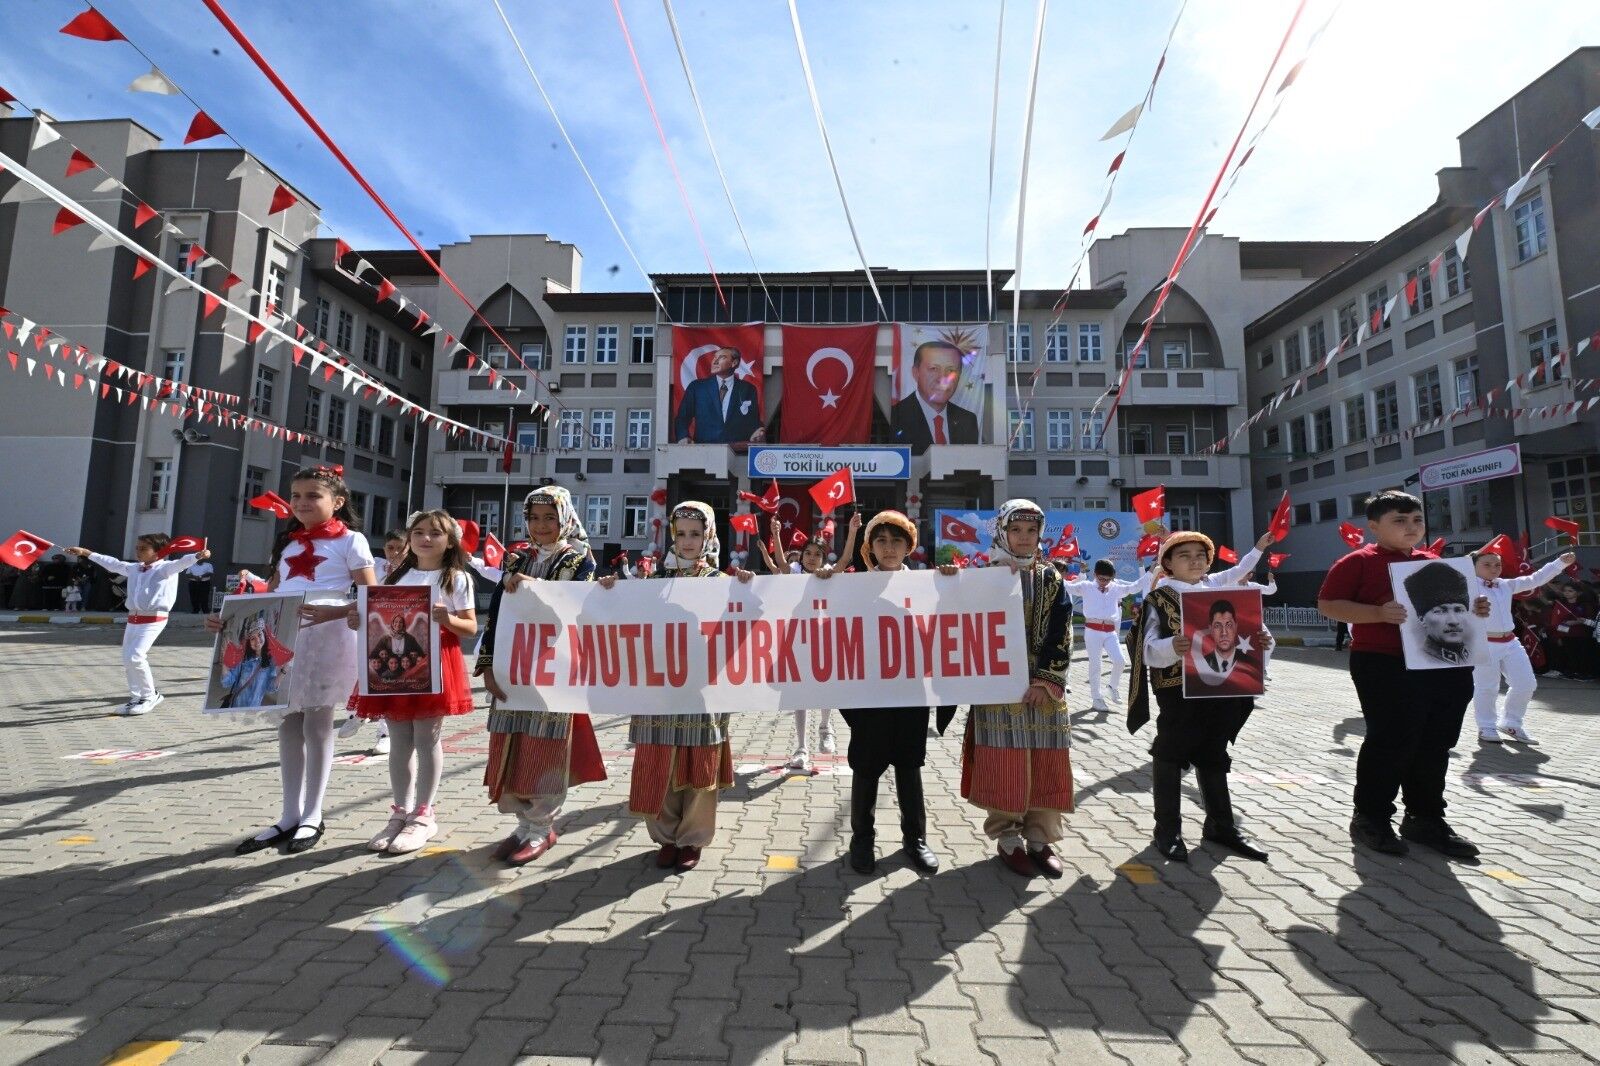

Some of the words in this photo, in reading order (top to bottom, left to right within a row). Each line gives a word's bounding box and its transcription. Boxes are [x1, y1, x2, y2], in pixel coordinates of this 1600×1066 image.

[784, 459, 813, 472] TOKİ
[1460, 461, 1502, 477] ANASINIFI
[509, 623, 556, 686] NE
[567, 622, 688, 688] MUTLU
[700, 599, 865, 686] TÜRK'ÜM
[878, 597, 1010, 680] DİYENE
